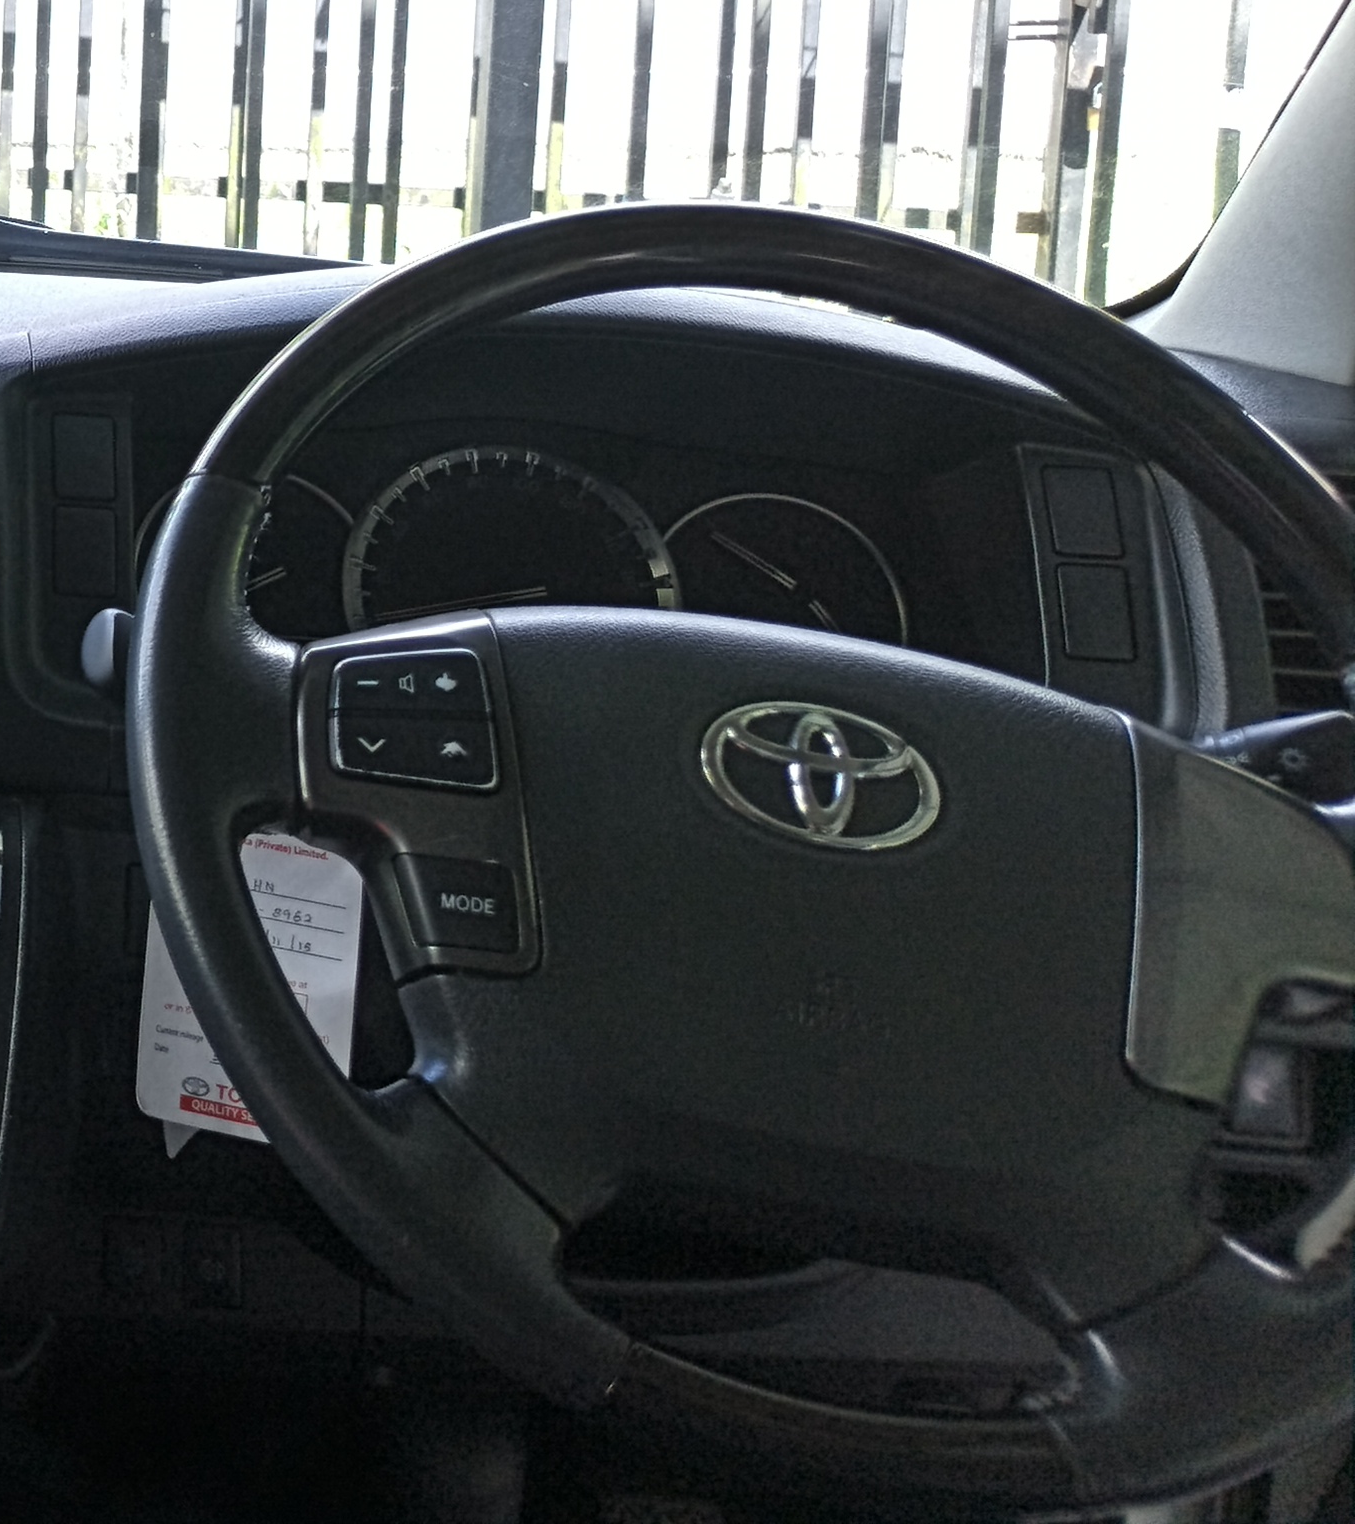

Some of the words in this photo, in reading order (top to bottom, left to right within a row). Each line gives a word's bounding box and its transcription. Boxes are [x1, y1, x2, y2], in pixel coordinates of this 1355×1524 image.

[254, 839, 292, 854] (Private)
[294, 846, 329, 861] Limited.
[441, 892, 495, 915] MODE
[191, 1098, 238, 1119] QUALITY
